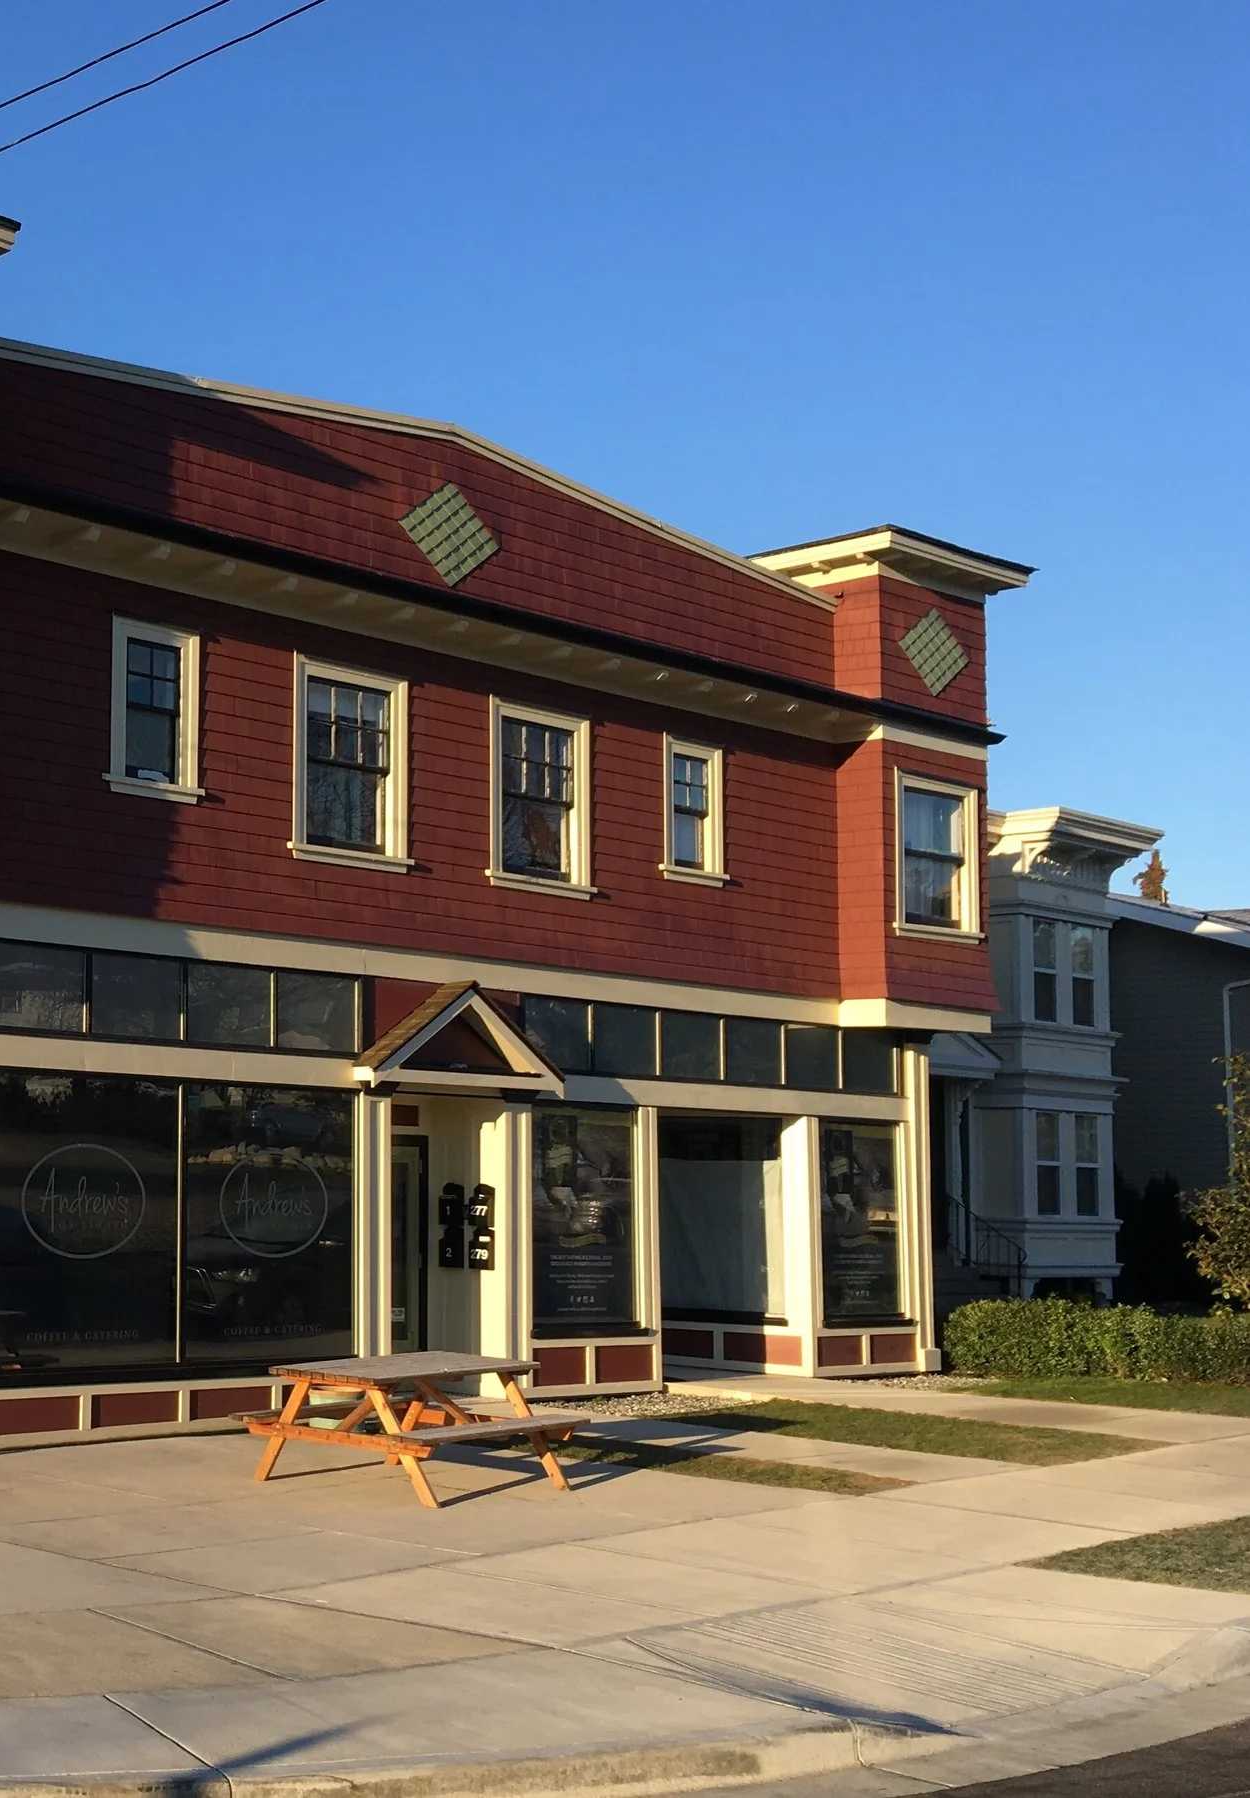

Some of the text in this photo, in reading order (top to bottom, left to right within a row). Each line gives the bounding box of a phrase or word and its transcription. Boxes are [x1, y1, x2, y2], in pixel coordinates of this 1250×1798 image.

[39, 1167, 128, 1234] Andrew's
[235, 1172, 312, 1234] Andrew's
[445, 1205, 451, 1216] 1
[470, 1205, 488, 1216] 277
[445, 1247, 452, 1258] 2
[470, 1248, 489, 1260] 279
[85, 1328, 139, 1340] CATERING
[274, 1322, 322, 1335] CATERING
